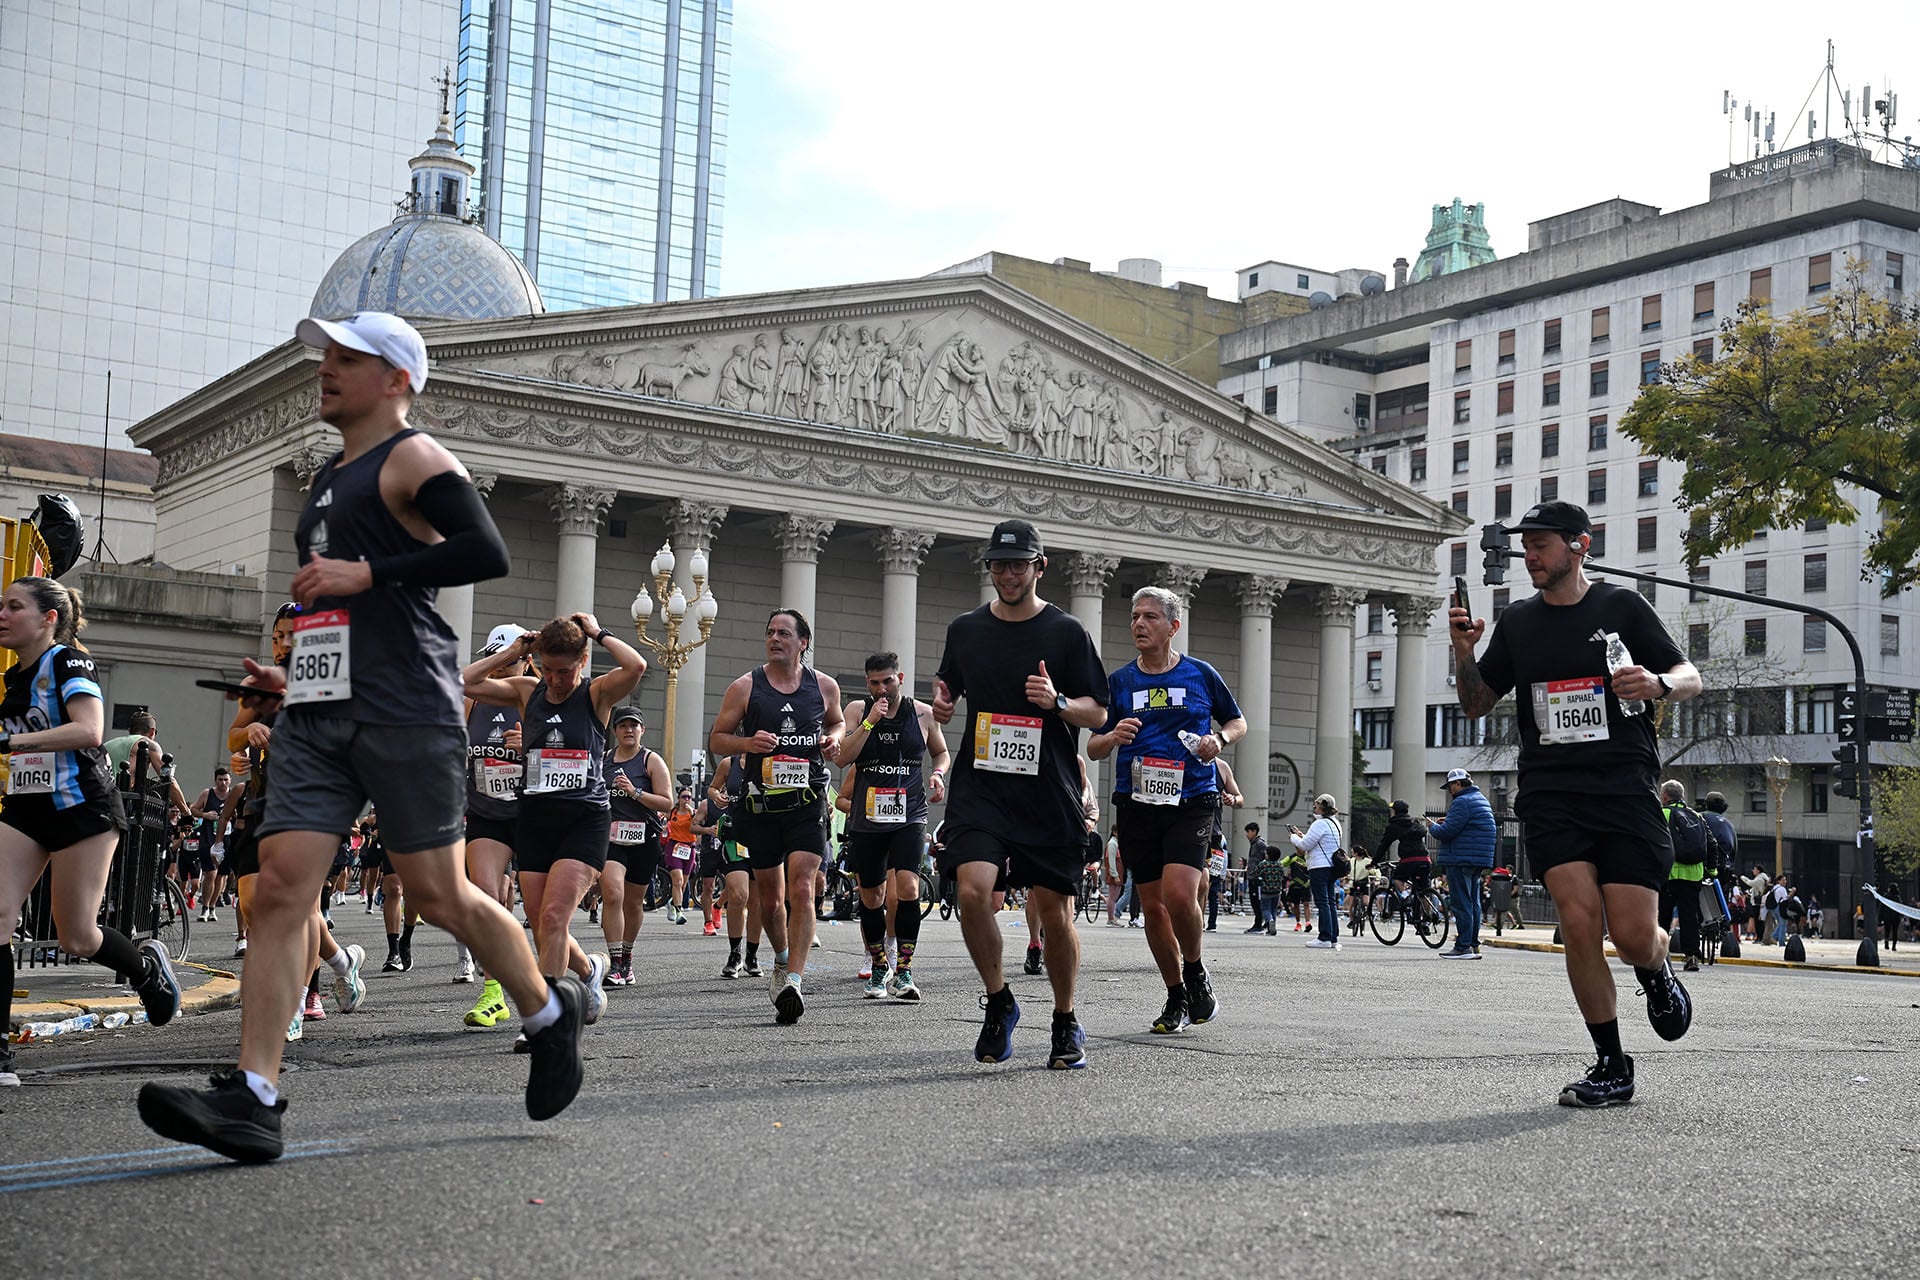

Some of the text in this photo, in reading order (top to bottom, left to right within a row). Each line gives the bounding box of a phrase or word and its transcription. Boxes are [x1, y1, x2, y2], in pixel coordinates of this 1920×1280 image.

[302, 631, 341, 648] BERNARDO
[1132, 687, 1186, 710] FRT
[1536, 690, 1543, 702] H
[1567, 693, 1596, 704] RAPHAEL
[1887, 694, 1910, 702] Avenida
[1554, 707, 1602, 729] 15640
[775, 733, 817, 746] rsonal
[878, 732, 900, 741] VOLT
[1013, 730, 1028, 739] CAIO
[993, 741, 1036, 762] 13253
[24, 756, 44, 766] MARIA
[557, 760, 581, 769] LUCIANA
[12, 770, 51, 790] 14069
[775, 773, 806, 785] 12722
[1157, 770, 1176, 779] SERGIO
[489, 776, 521, 793] 16187
[544, 773, 583, 789] 16285
[1144, 779, 1179, 796] 15866
[877, 803, 904, 815] 14068
[620, 829, 643, 841] 17888
